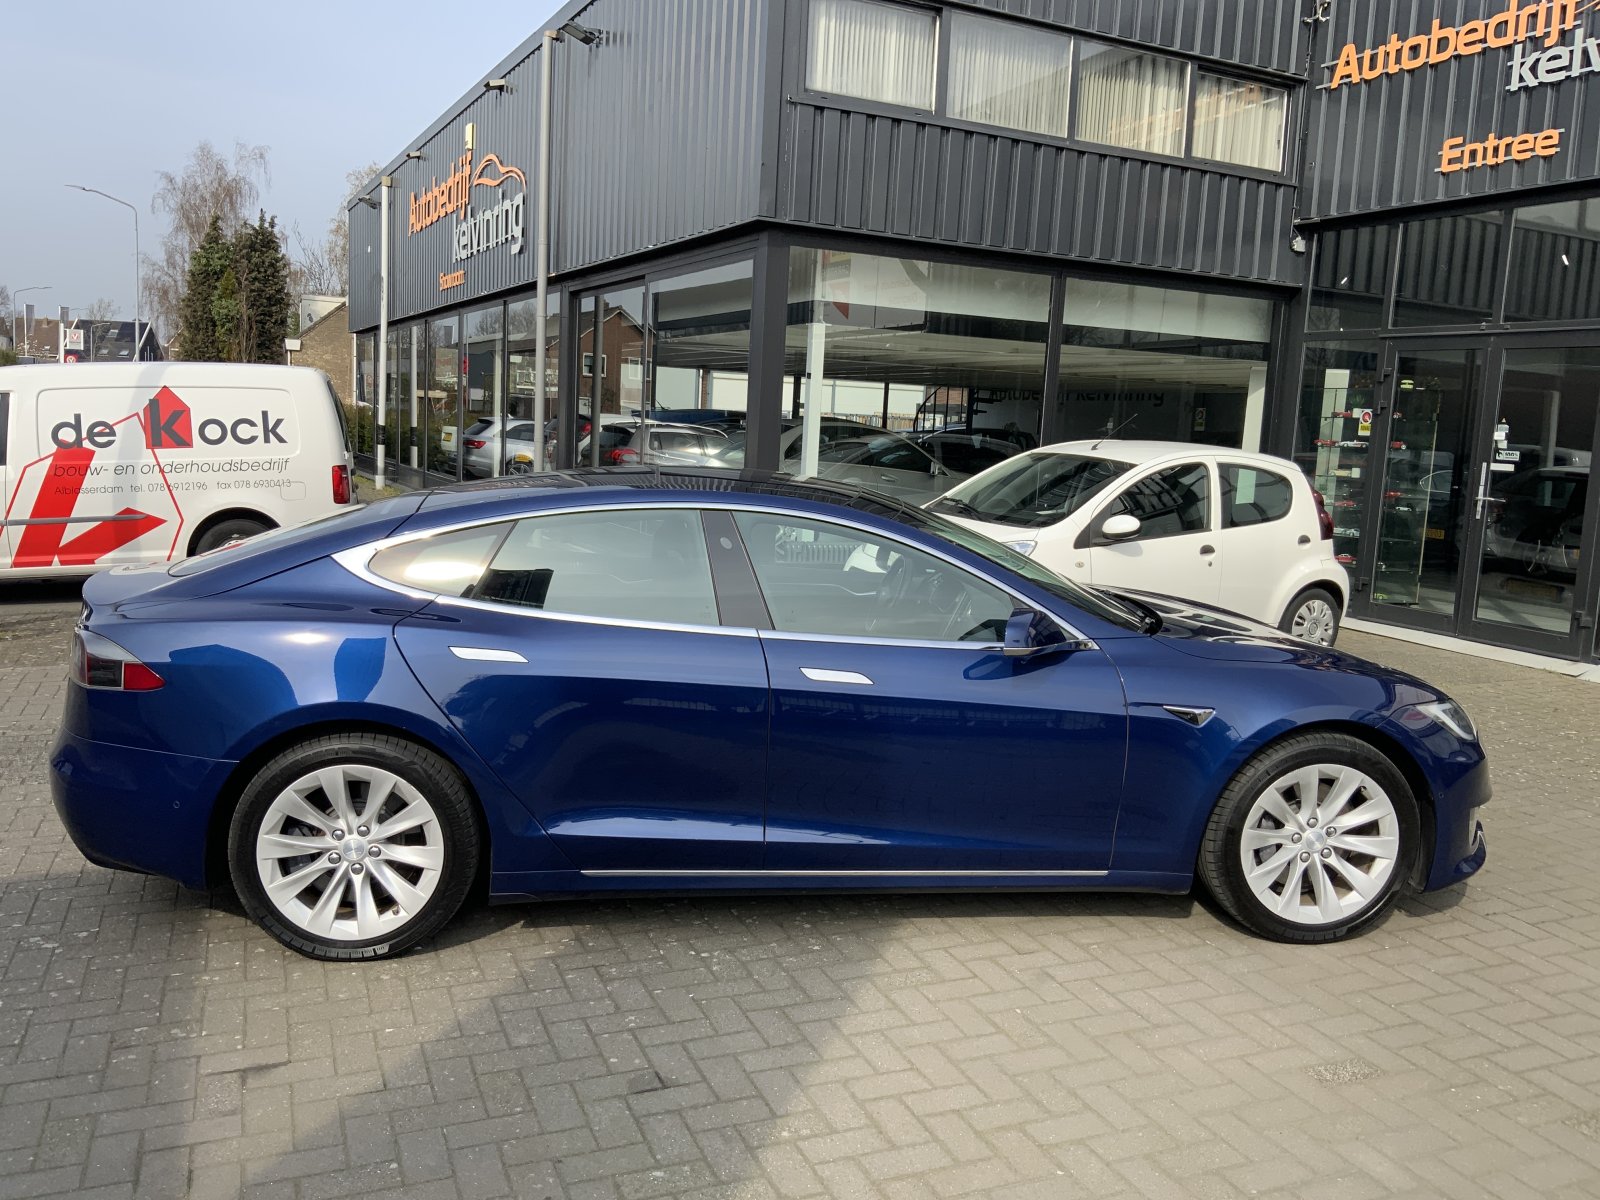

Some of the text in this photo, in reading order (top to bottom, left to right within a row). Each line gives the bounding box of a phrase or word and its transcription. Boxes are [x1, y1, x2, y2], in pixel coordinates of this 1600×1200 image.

[1331, 0, 1577, 89] Autobedrijf
[1440, 128, 1560, 173] Entree
[407, 150, 473, 237] Autobedrijf
[453, 188, 524, 263] kelvinring
[51, 413, 117, 449] de
[54, 458, 290, 477] bouw- en onderhoudsbedrijf
[54, 485, 124, 495] Alblasserdam
[216, 481, 232, 490] fax
[234, 479, 251, 489] 078
